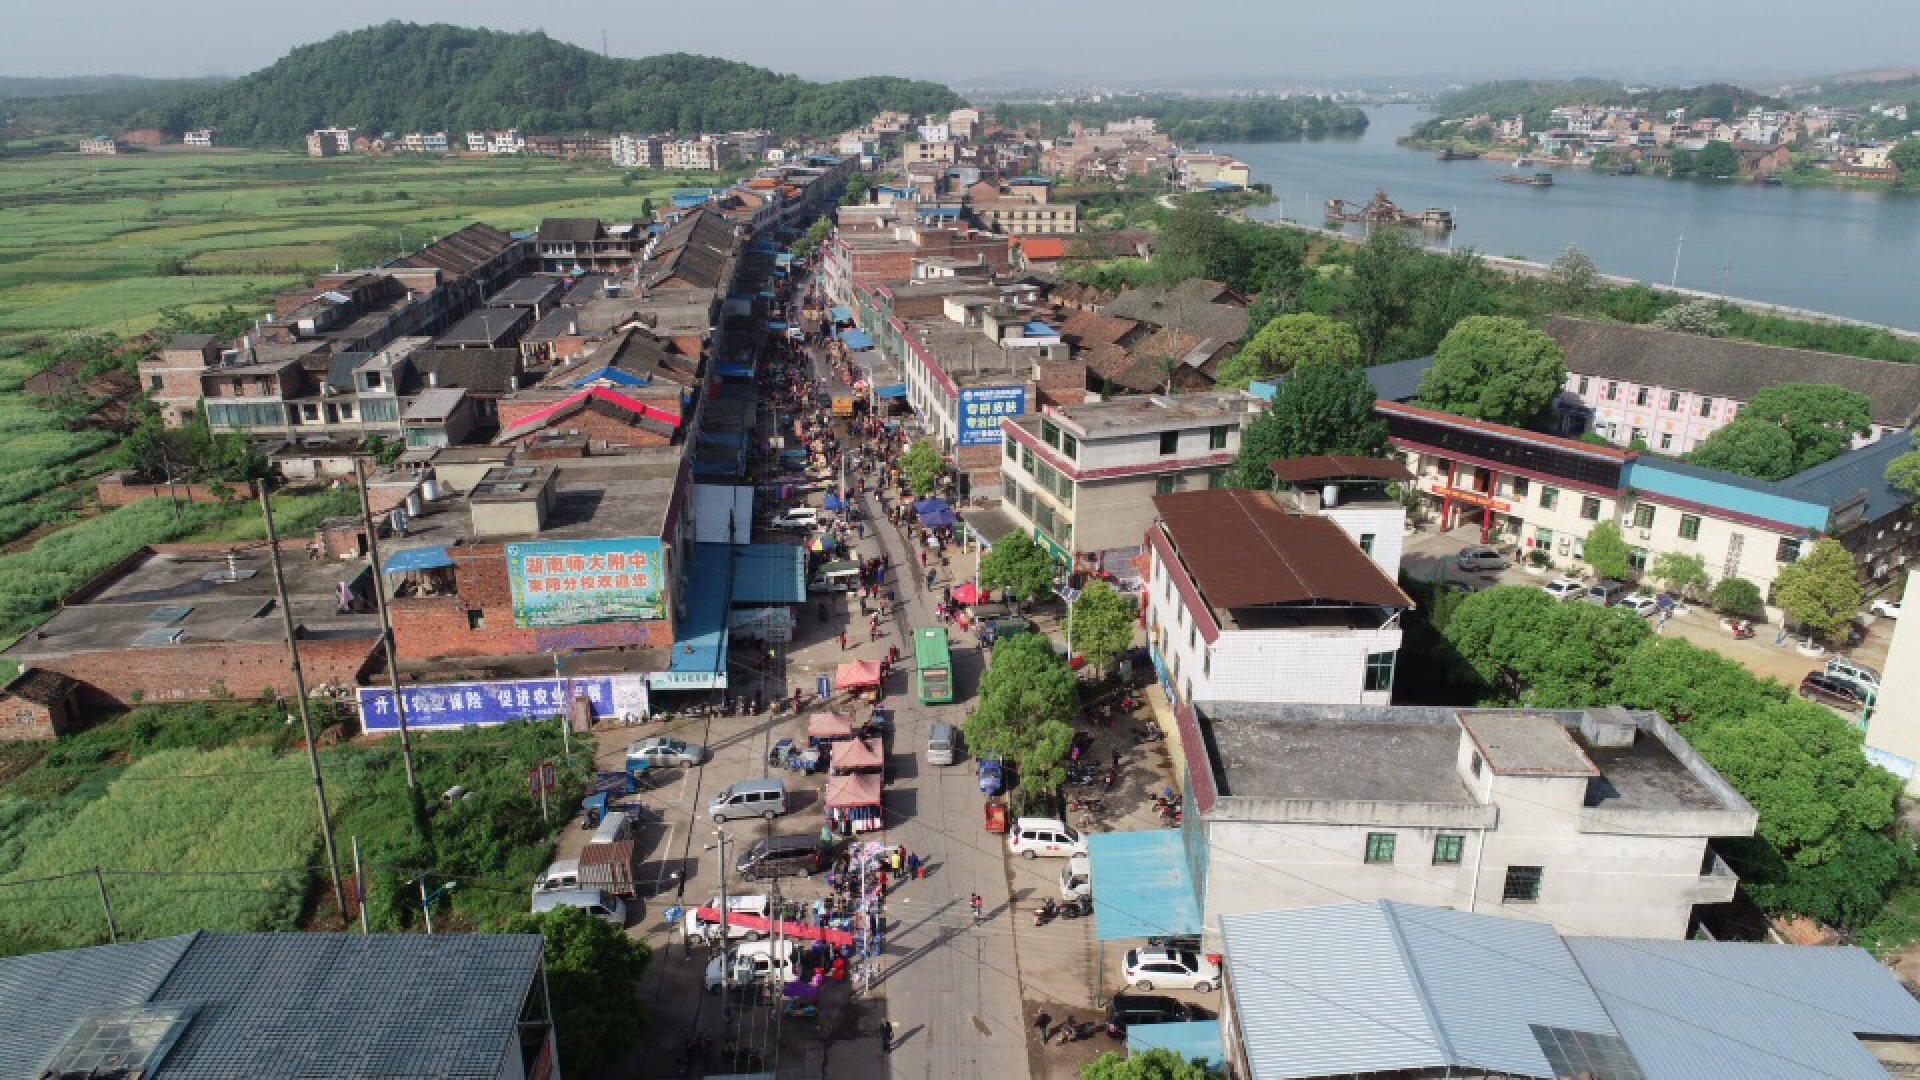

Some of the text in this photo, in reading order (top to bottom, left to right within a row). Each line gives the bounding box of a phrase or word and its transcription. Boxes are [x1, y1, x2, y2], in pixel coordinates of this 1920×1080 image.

[525, 552, 648, 575] 湖南师大附中
